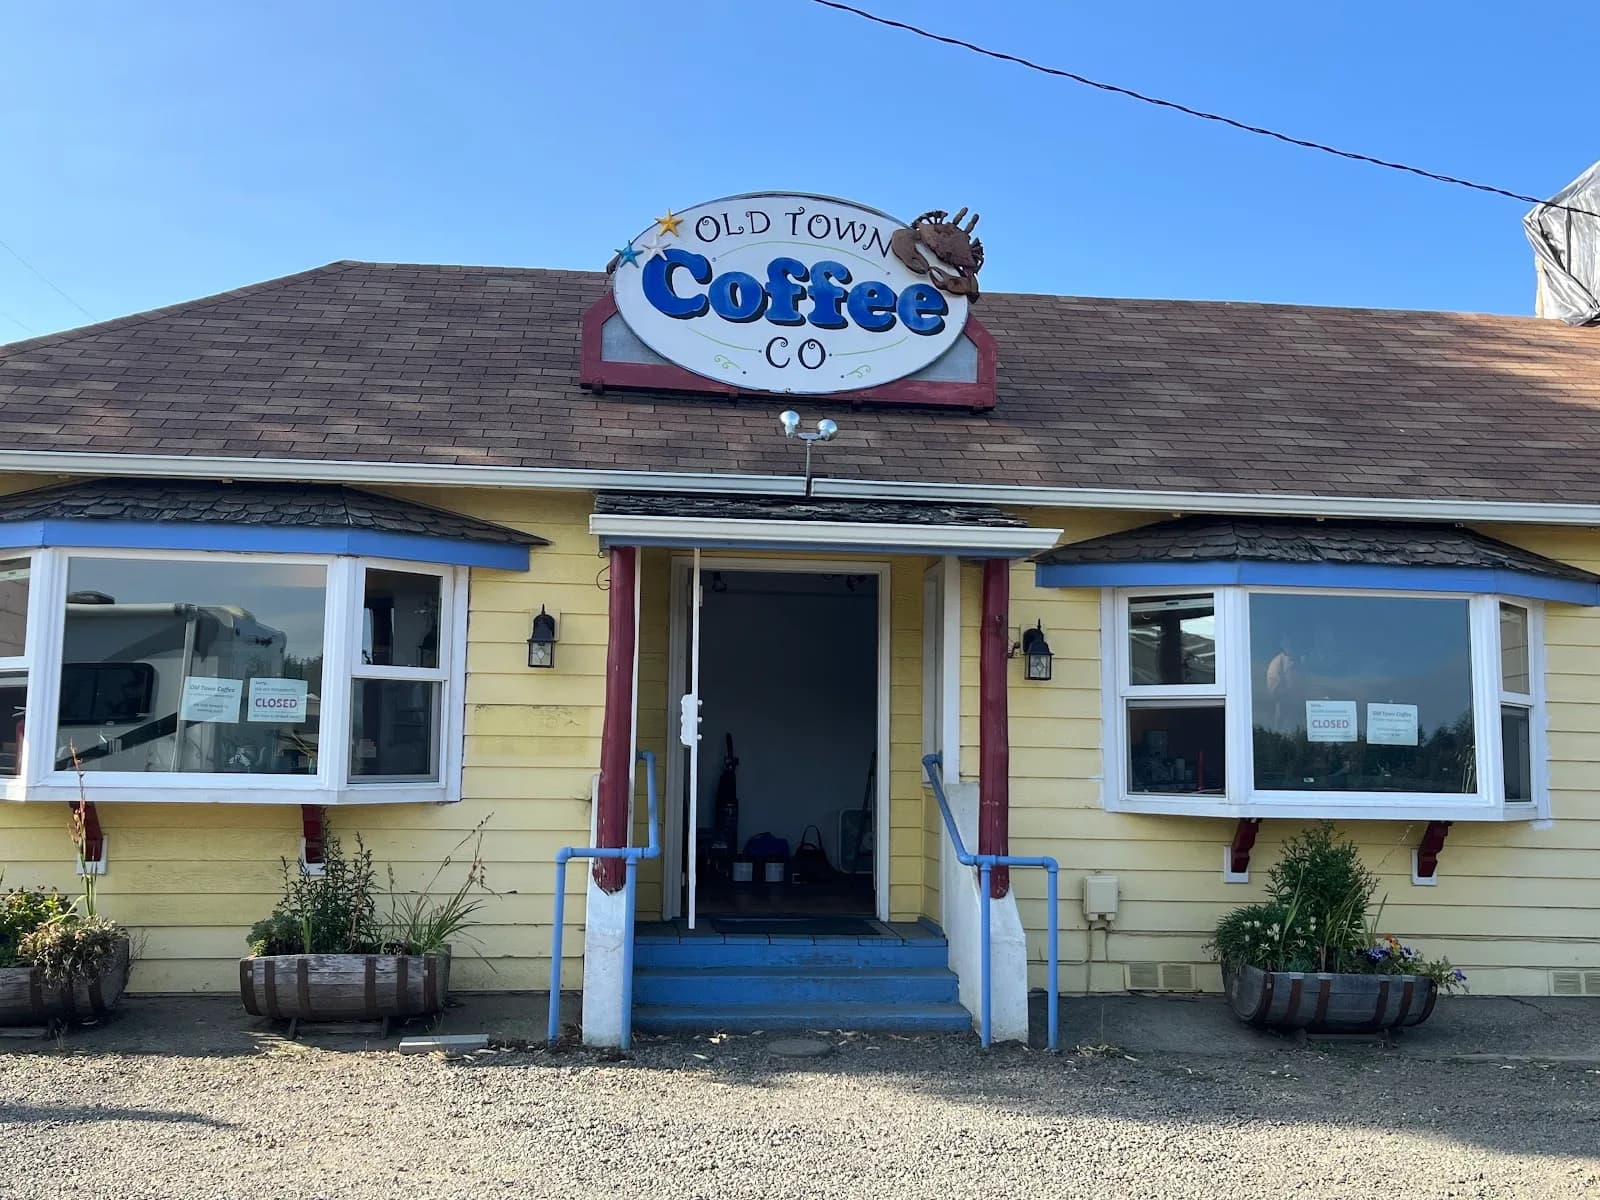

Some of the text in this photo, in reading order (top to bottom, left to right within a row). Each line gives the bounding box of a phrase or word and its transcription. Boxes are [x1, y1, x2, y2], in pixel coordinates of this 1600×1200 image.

[695, 206, 893, 258] OLD TOWN
[642, 248, 949, 336] Coffee
[765, 336, 826, 370] CO
[255, 698, 297, 708] CLOSED
[1311, 719, 1349, 729] CLOSED
